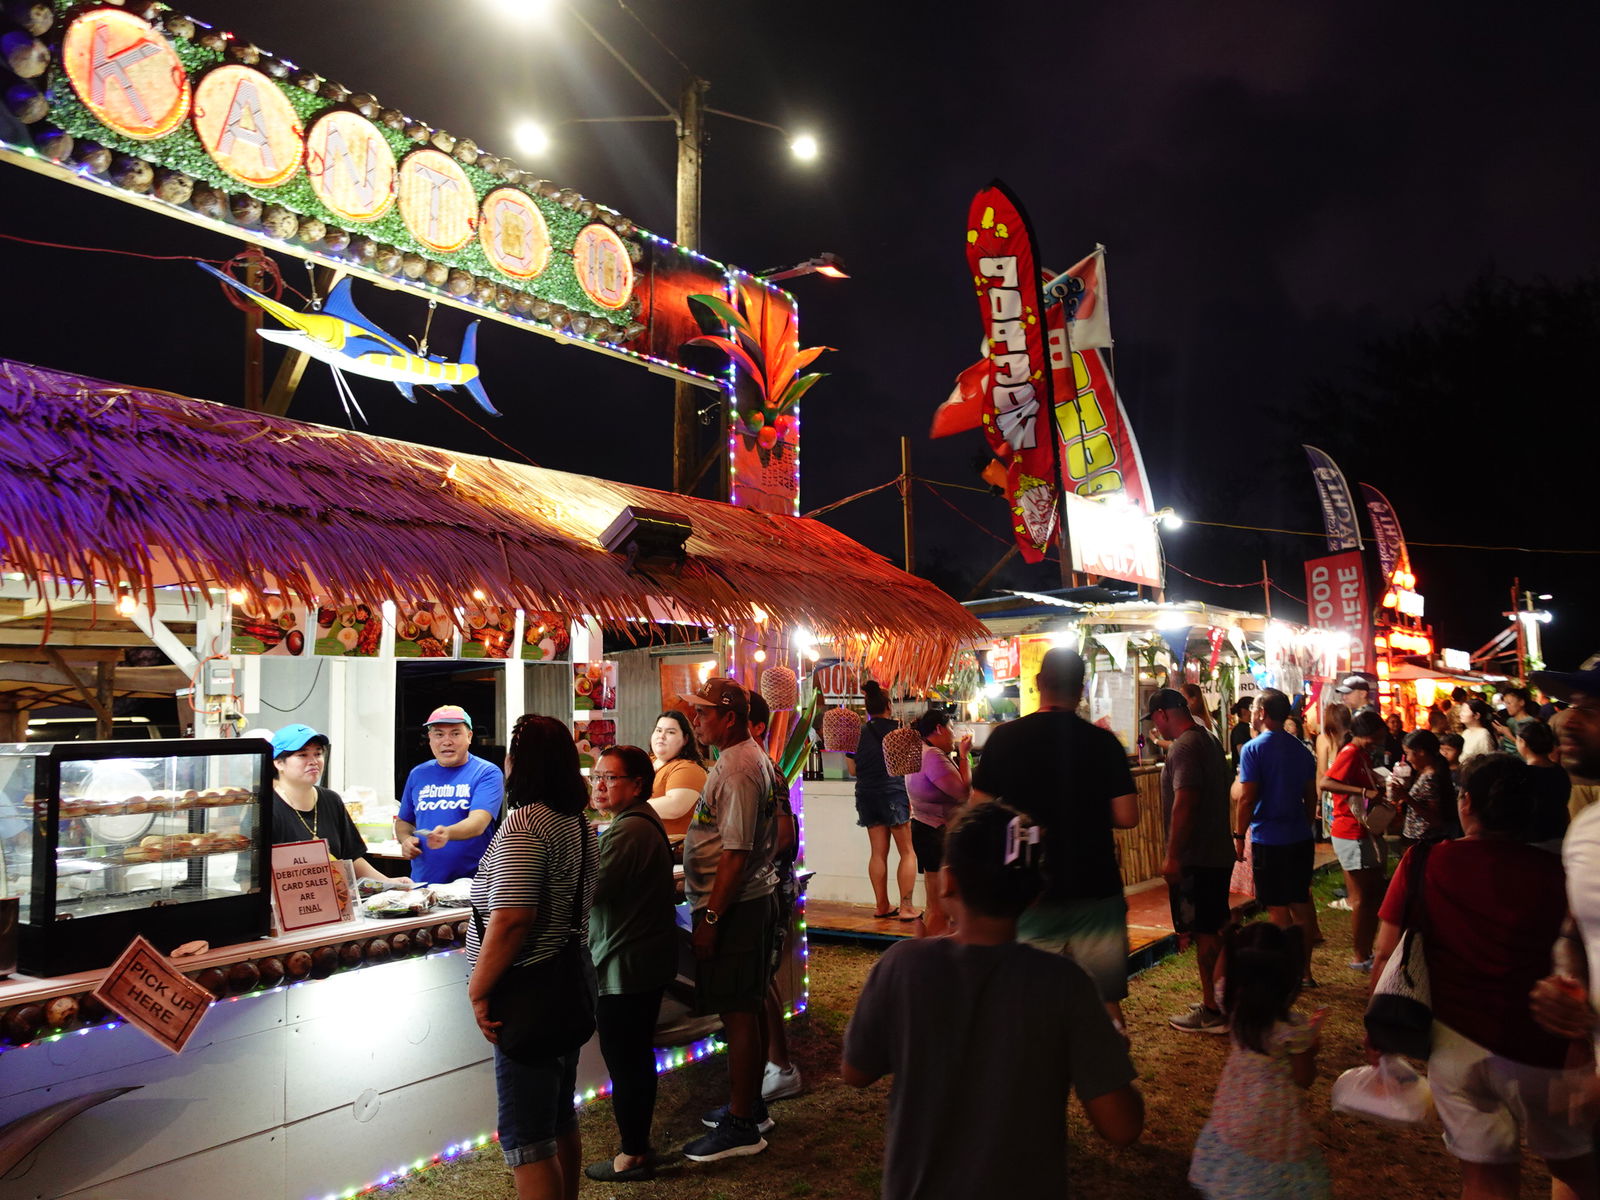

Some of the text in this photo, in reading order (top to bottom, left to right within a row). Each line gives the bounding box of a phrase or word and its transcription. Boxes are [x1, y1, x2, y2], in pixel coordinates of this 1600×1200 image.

[1337, 565, 1362, 630] HERE
[430, 783, 455, 798] Grotto
[293, 857, 308, 865] ALL
[276, 865, 329, 880] DEBIT/CREDIT
[281, 878, 328, 891] CARD SALES
[300, 892, 315, 901] ARE
[298, 903, 322, 914] FINAL
[130, 962, 195, 1012] PICK UP
[127, 985, 175, 1024] HERE
